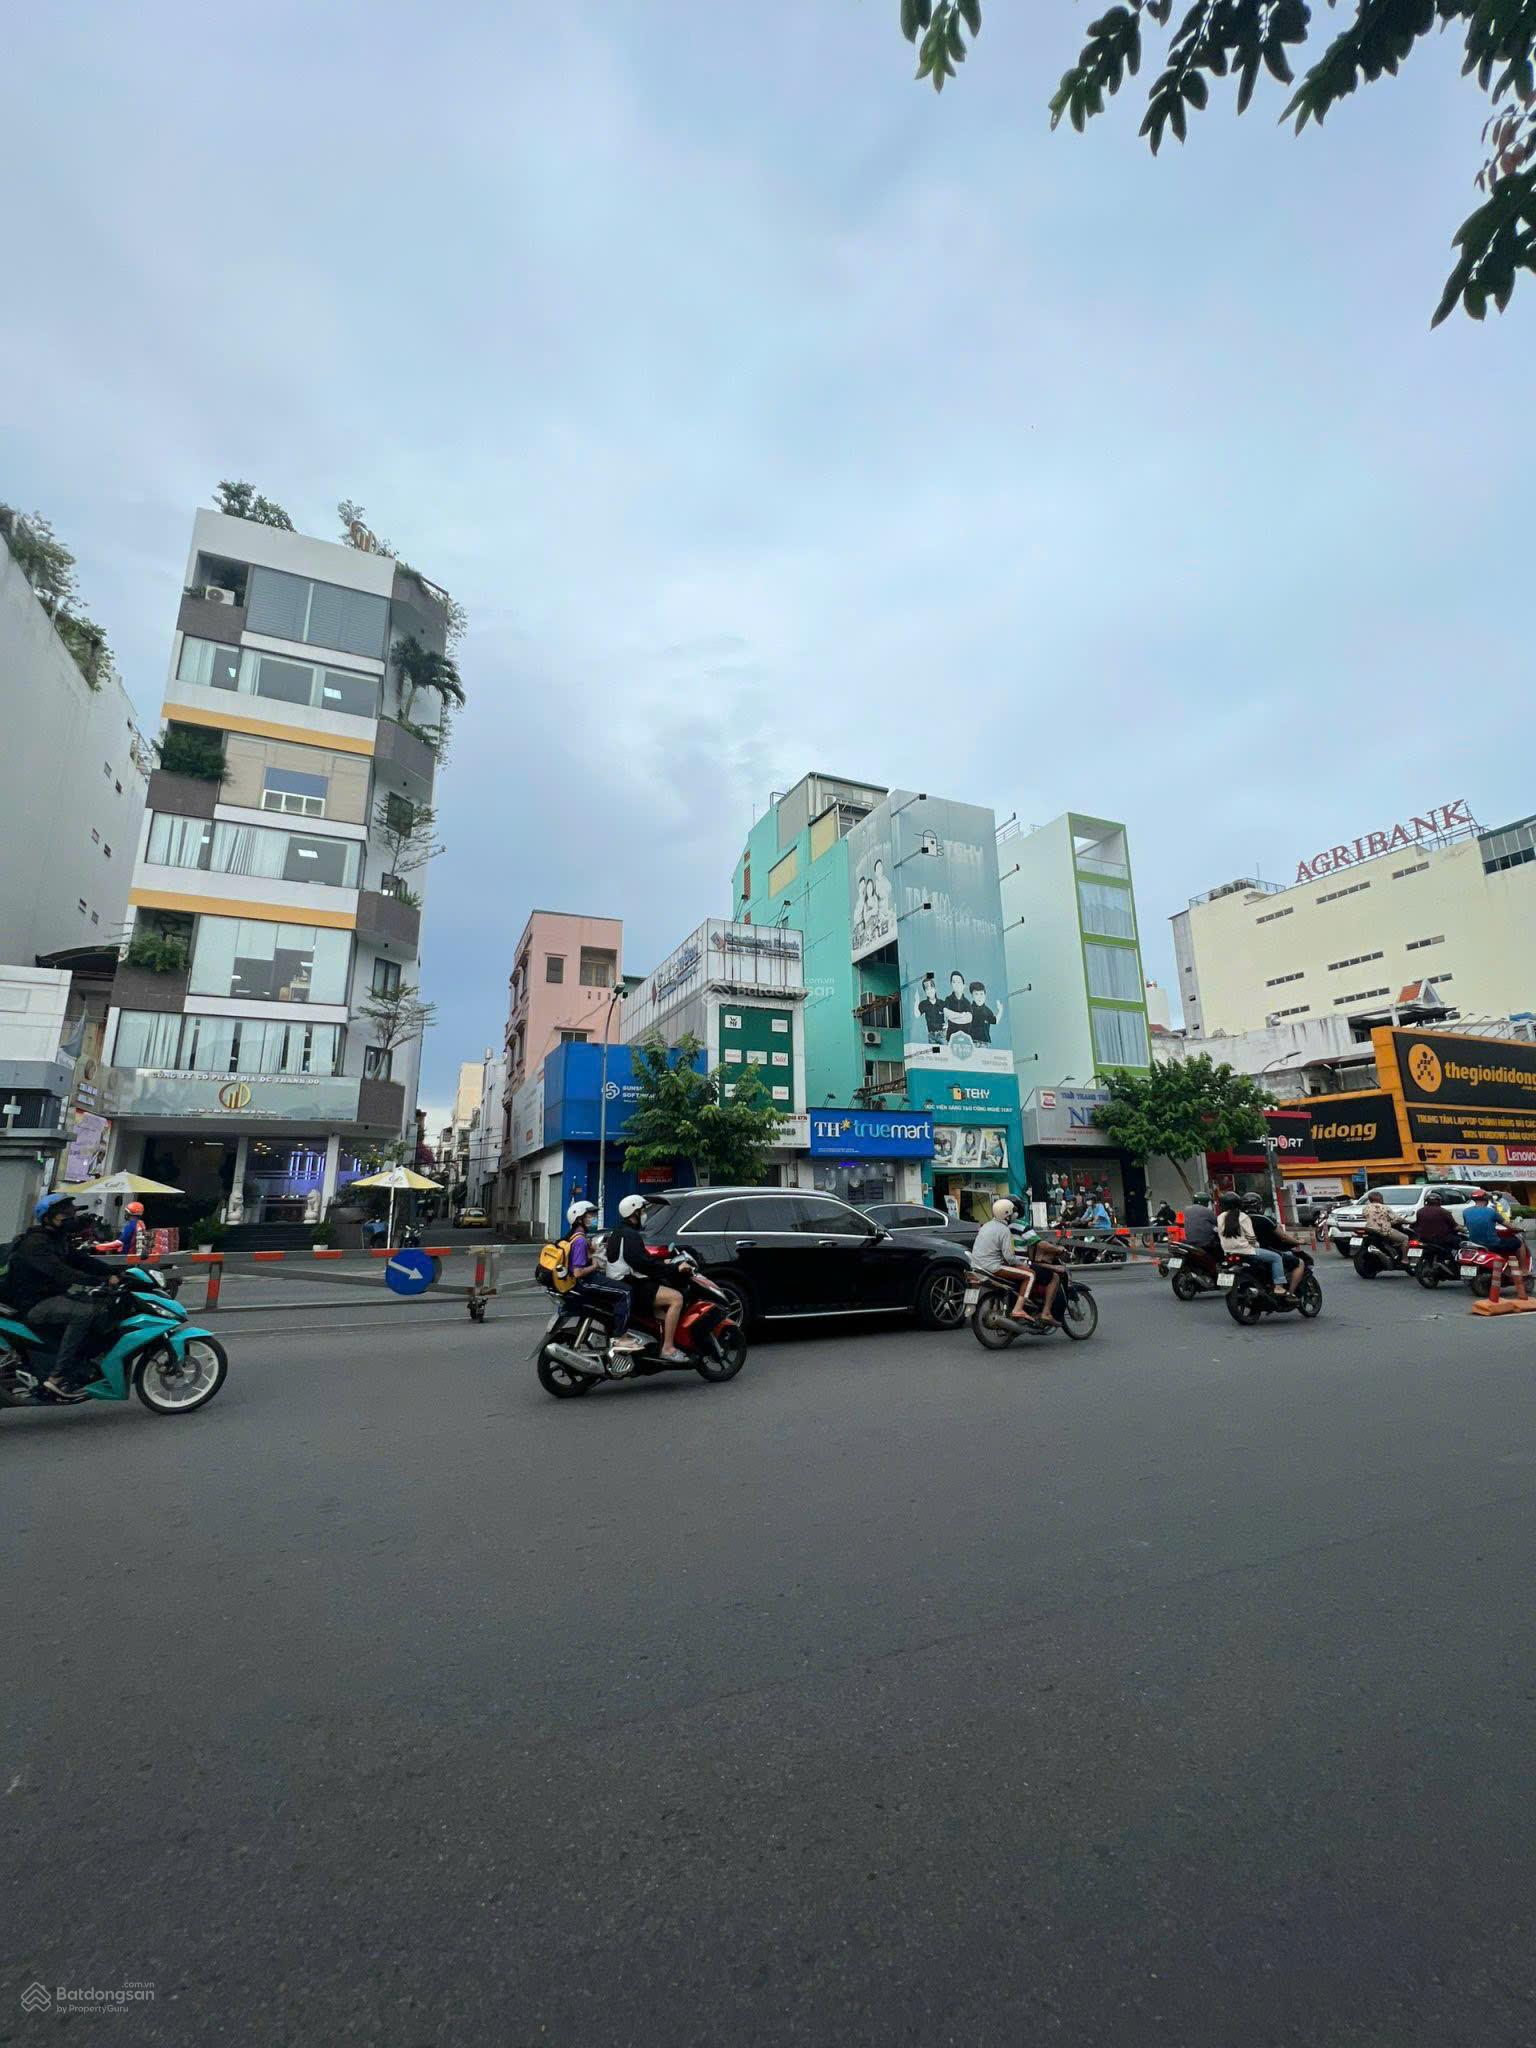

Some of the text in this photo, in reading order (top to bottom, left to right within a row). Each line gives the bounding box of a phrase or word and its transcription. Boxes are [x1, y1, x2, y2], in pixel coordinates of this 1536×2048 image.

[1295, 799, 1472, 883] AGRIBANK
[814, 1121, 840, 1137] TH
[1506, 1148, 1536, 1161] Lenovo
